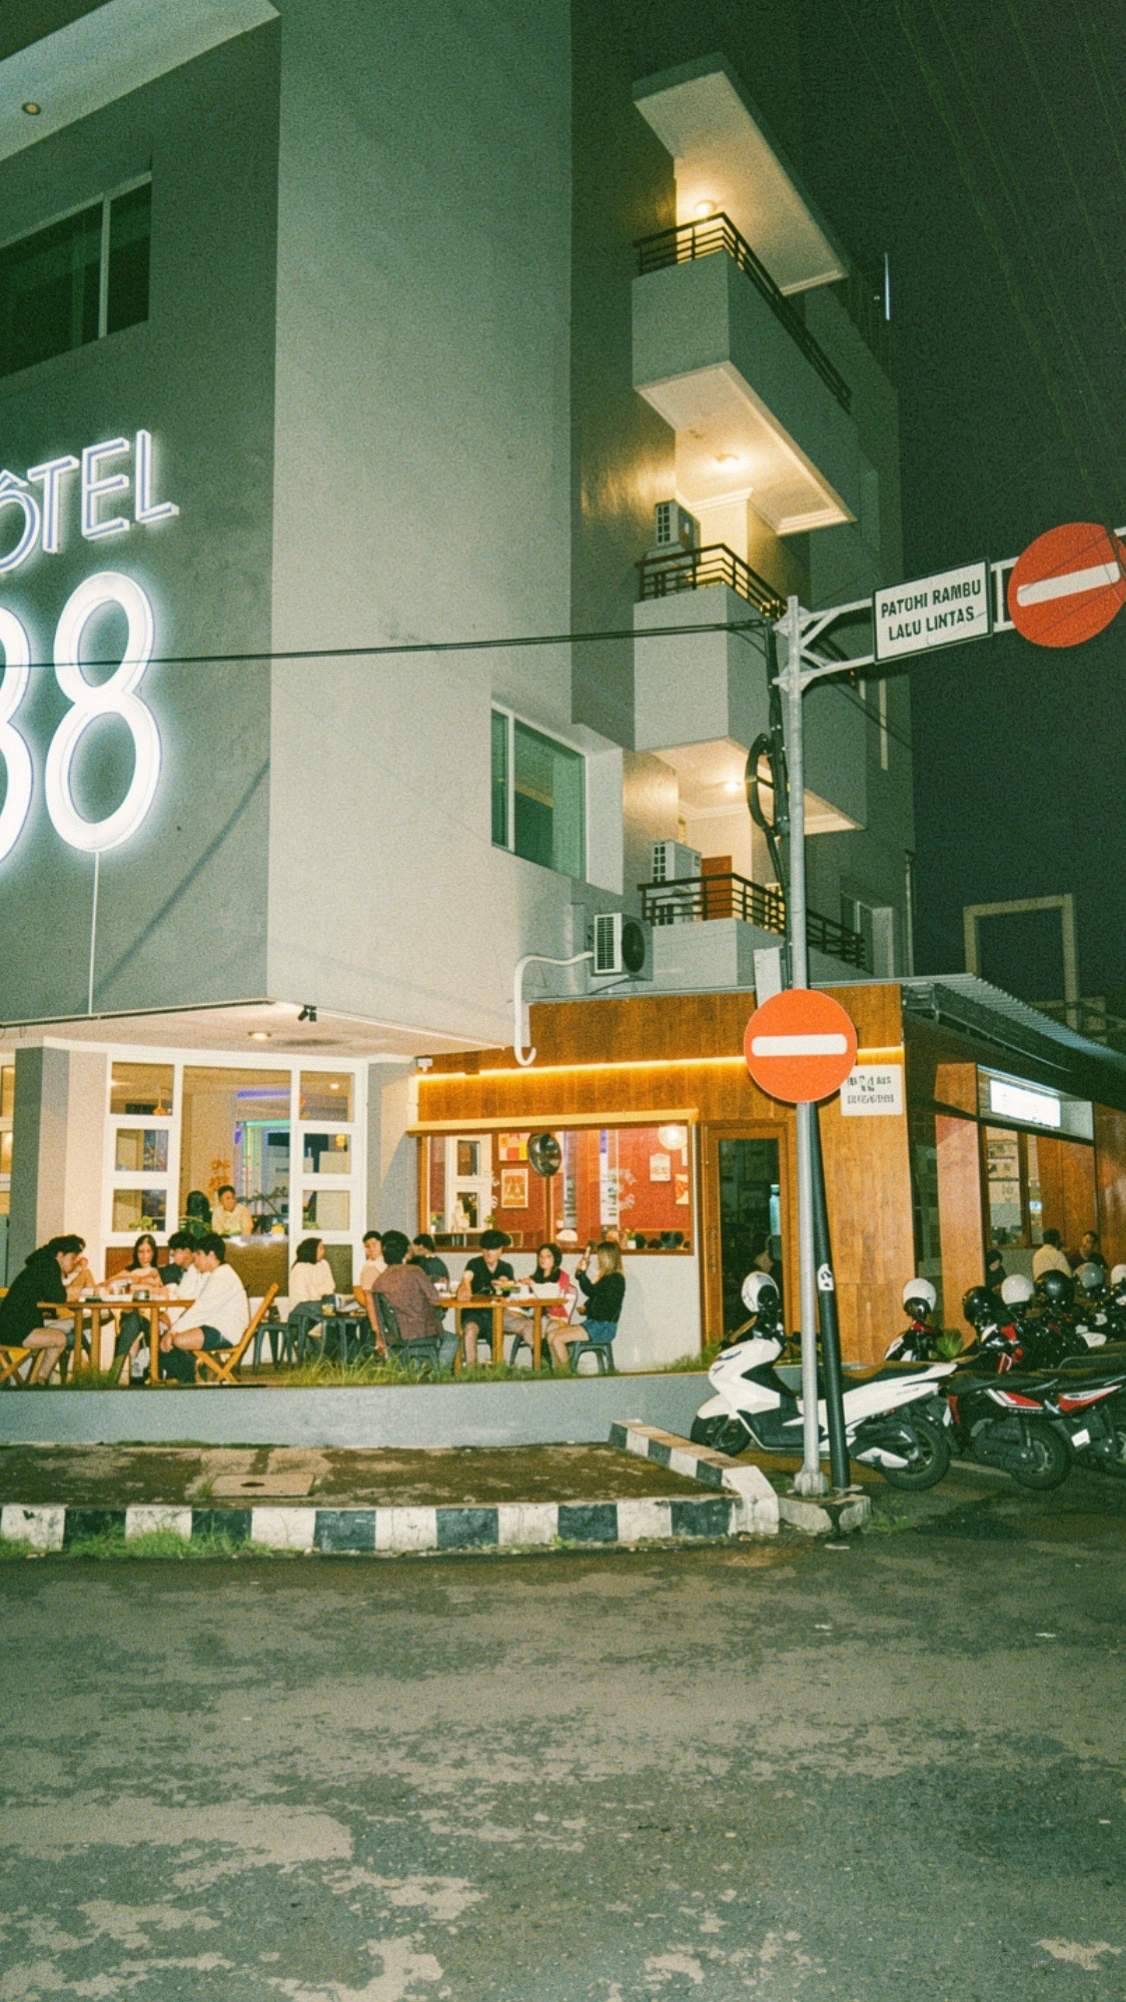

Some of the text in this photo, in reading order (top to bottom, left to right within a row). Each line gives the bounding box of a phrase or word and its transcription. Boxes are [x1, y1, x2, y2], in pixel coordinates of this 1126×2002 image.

[932, 579, 982, 605] RAMBU
[926, 606, 975, 632] LINTAS
[0, 570, 162, 863] 8
